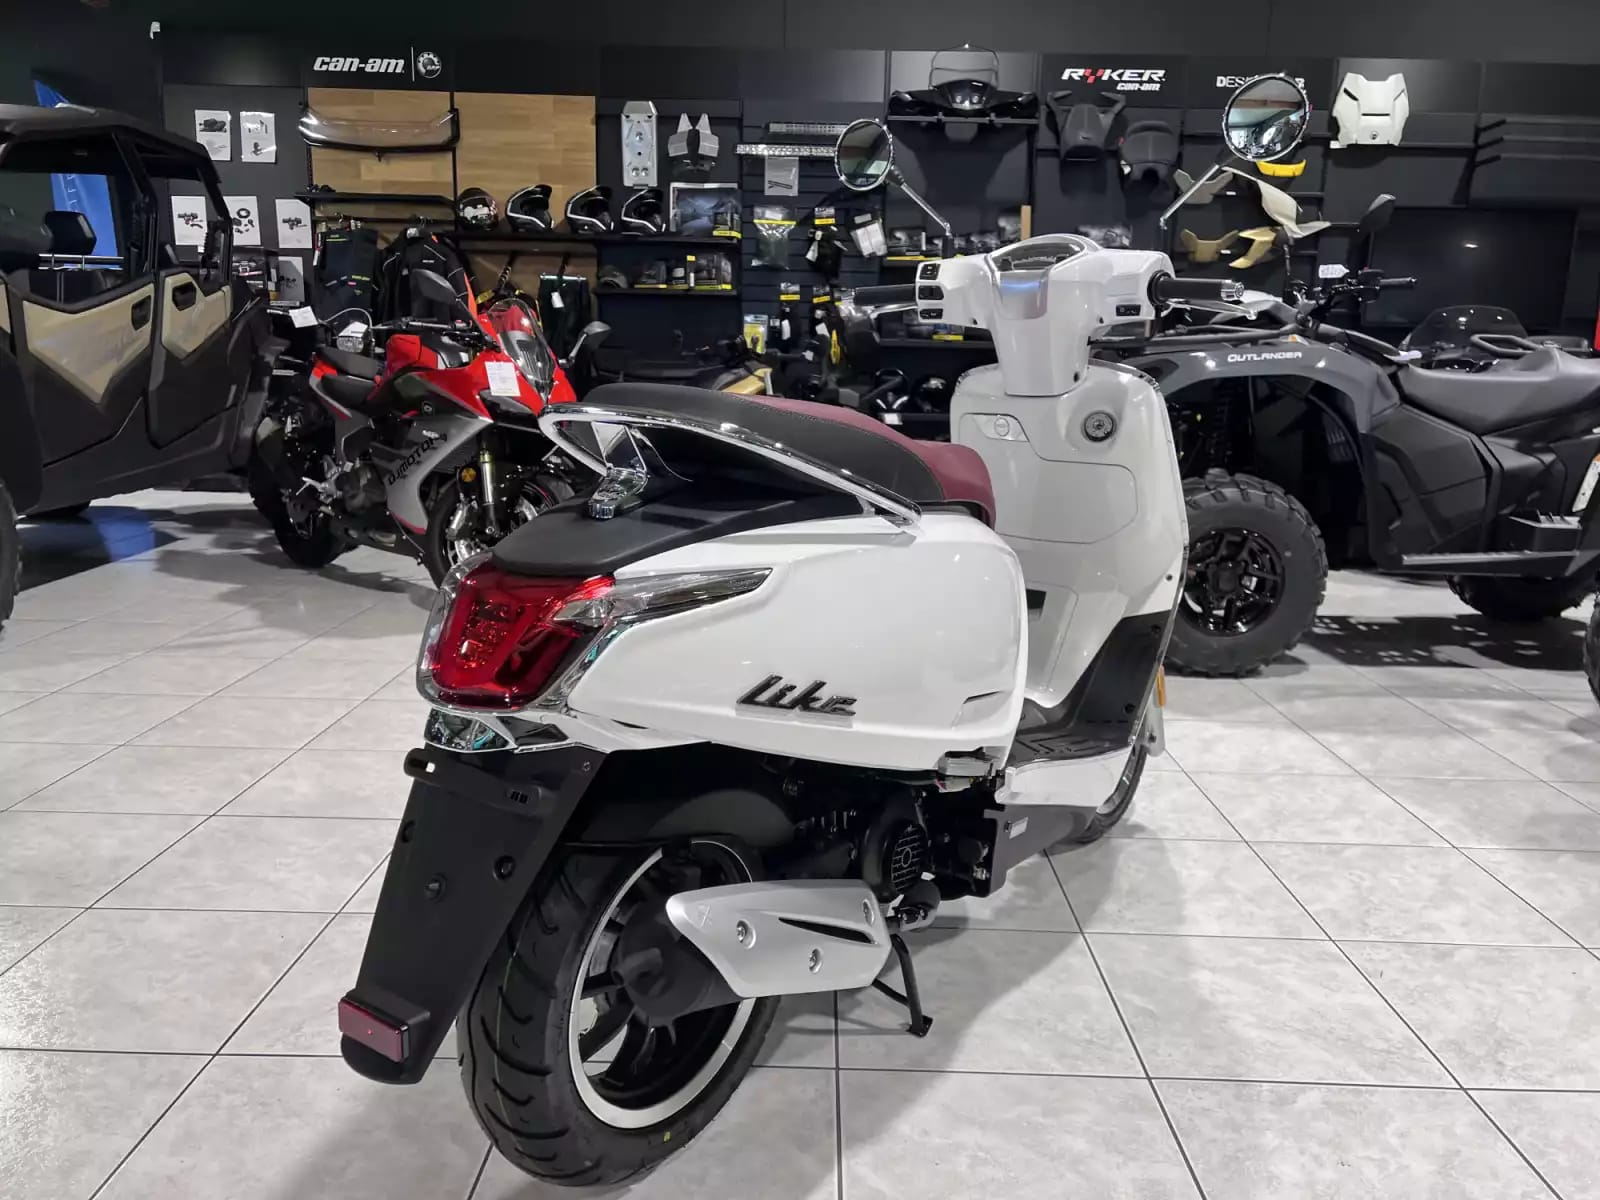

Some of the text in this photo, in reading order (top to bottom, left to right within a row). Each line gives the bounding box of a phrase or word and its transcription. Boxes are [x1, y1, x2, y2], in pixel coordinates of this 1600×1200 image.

[313, 56, 404, 74] can-am
[1061, 68, 1165, 84] RYKER
[1116, 81, 1161, 92] can-am
[1227, 351, 1302, 363] OUTLANDER
[736, 673, 857, 716] Like
